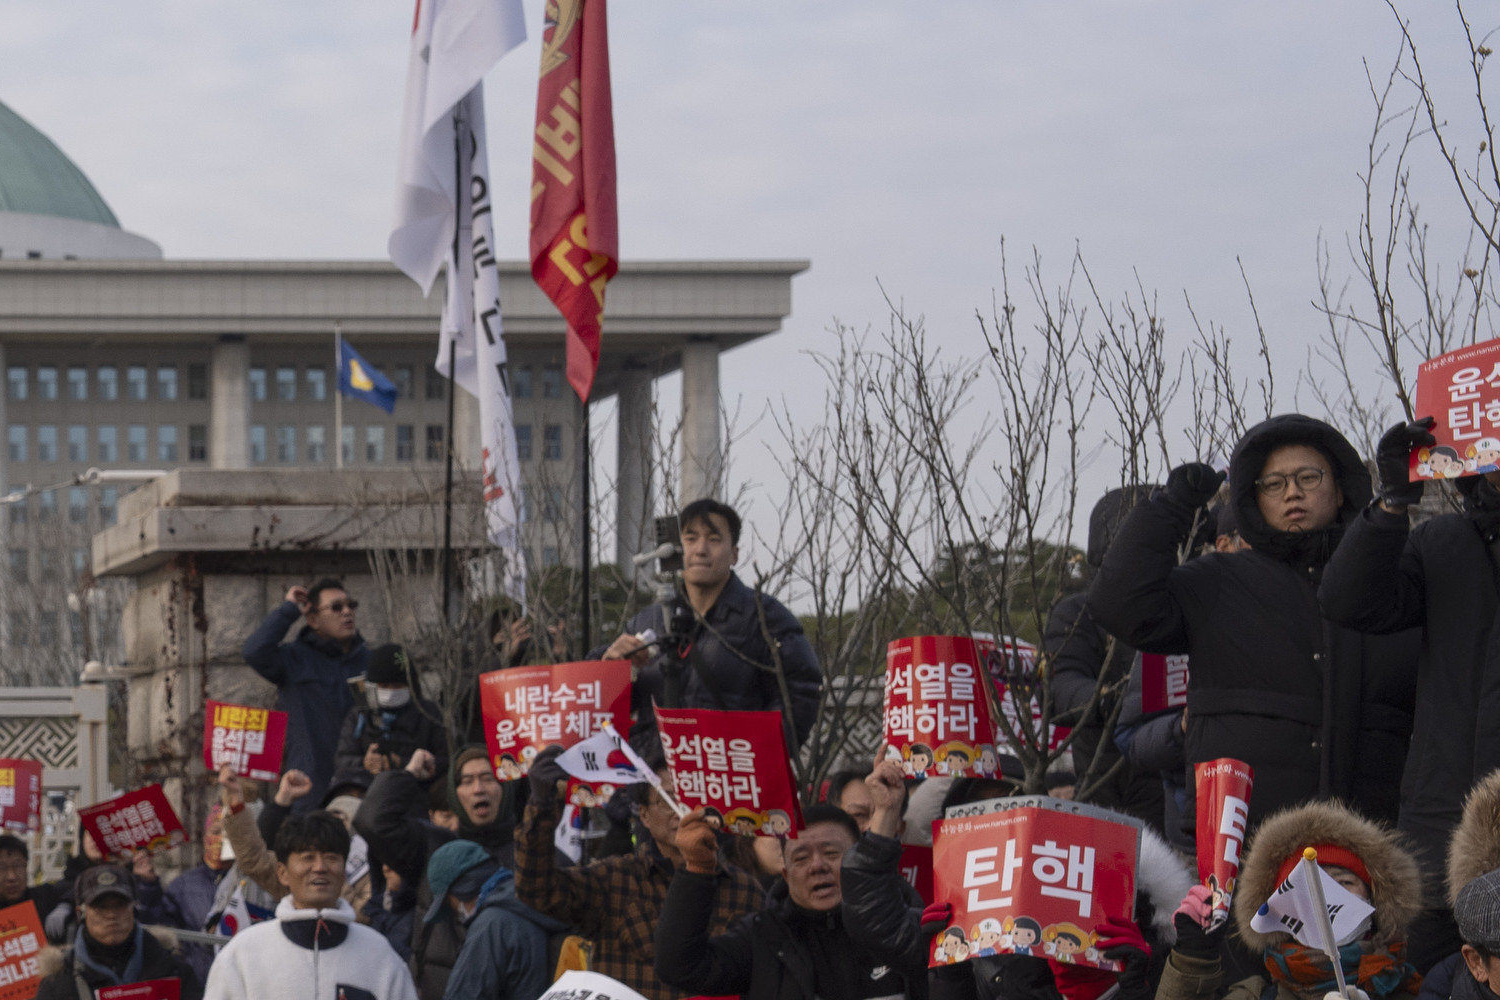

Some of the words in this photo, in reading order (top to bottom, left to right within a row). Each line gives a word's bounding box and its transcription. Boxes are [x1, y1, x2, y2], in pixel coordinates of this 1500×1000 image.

[505, 679, 601, 714] 내란수괴
[214, 705, 269, 731] 내란죄
[496, 714, 562, 749] 윤석열
[212, 727, 266, 755] 윤석열
[661, 731, 756, 772] 윤석열을
[973, 814, 1028, 832] www.nanum.com
[963, 838, 1096, 917] 탄핵
